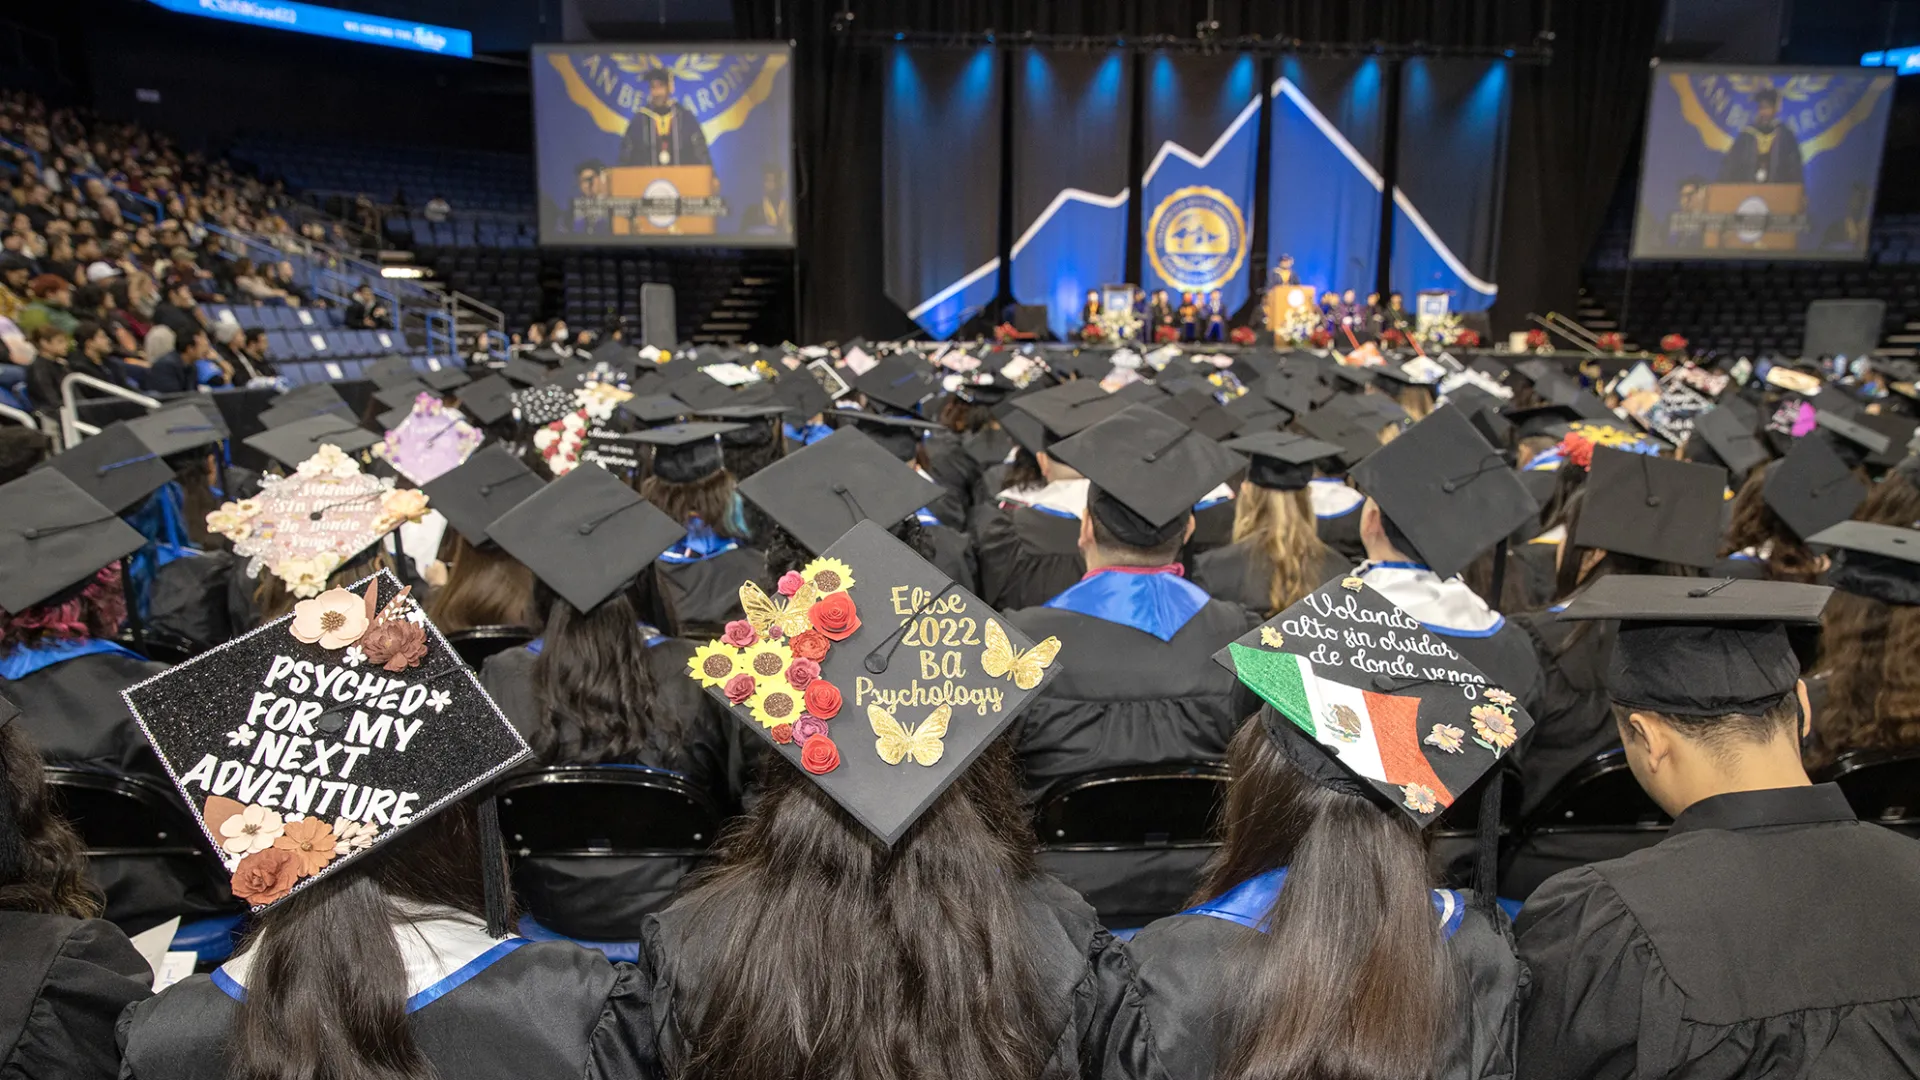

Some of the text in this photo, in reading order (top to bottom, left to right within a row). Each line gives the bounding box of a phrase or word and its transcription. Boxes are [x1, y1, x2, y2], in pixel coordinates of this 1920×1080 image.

[890, 585, 967, 615] Elise
[1304, 592, 1421, 630] Volando
[900, 616, 981, 647] 2022
[1281, 616, 1459, 660] alto sin olvidar
[263, 655, 427, 715] PSYCHED
[1309, 643, 1487, 700] de donde vengo
[855, 676, 1004, 716] Psychology
[246, 691, 424, 752] FOR MY
[250, 731, 371, 780] NEXT
[180, 753, 420, 827] ADVENTURE
